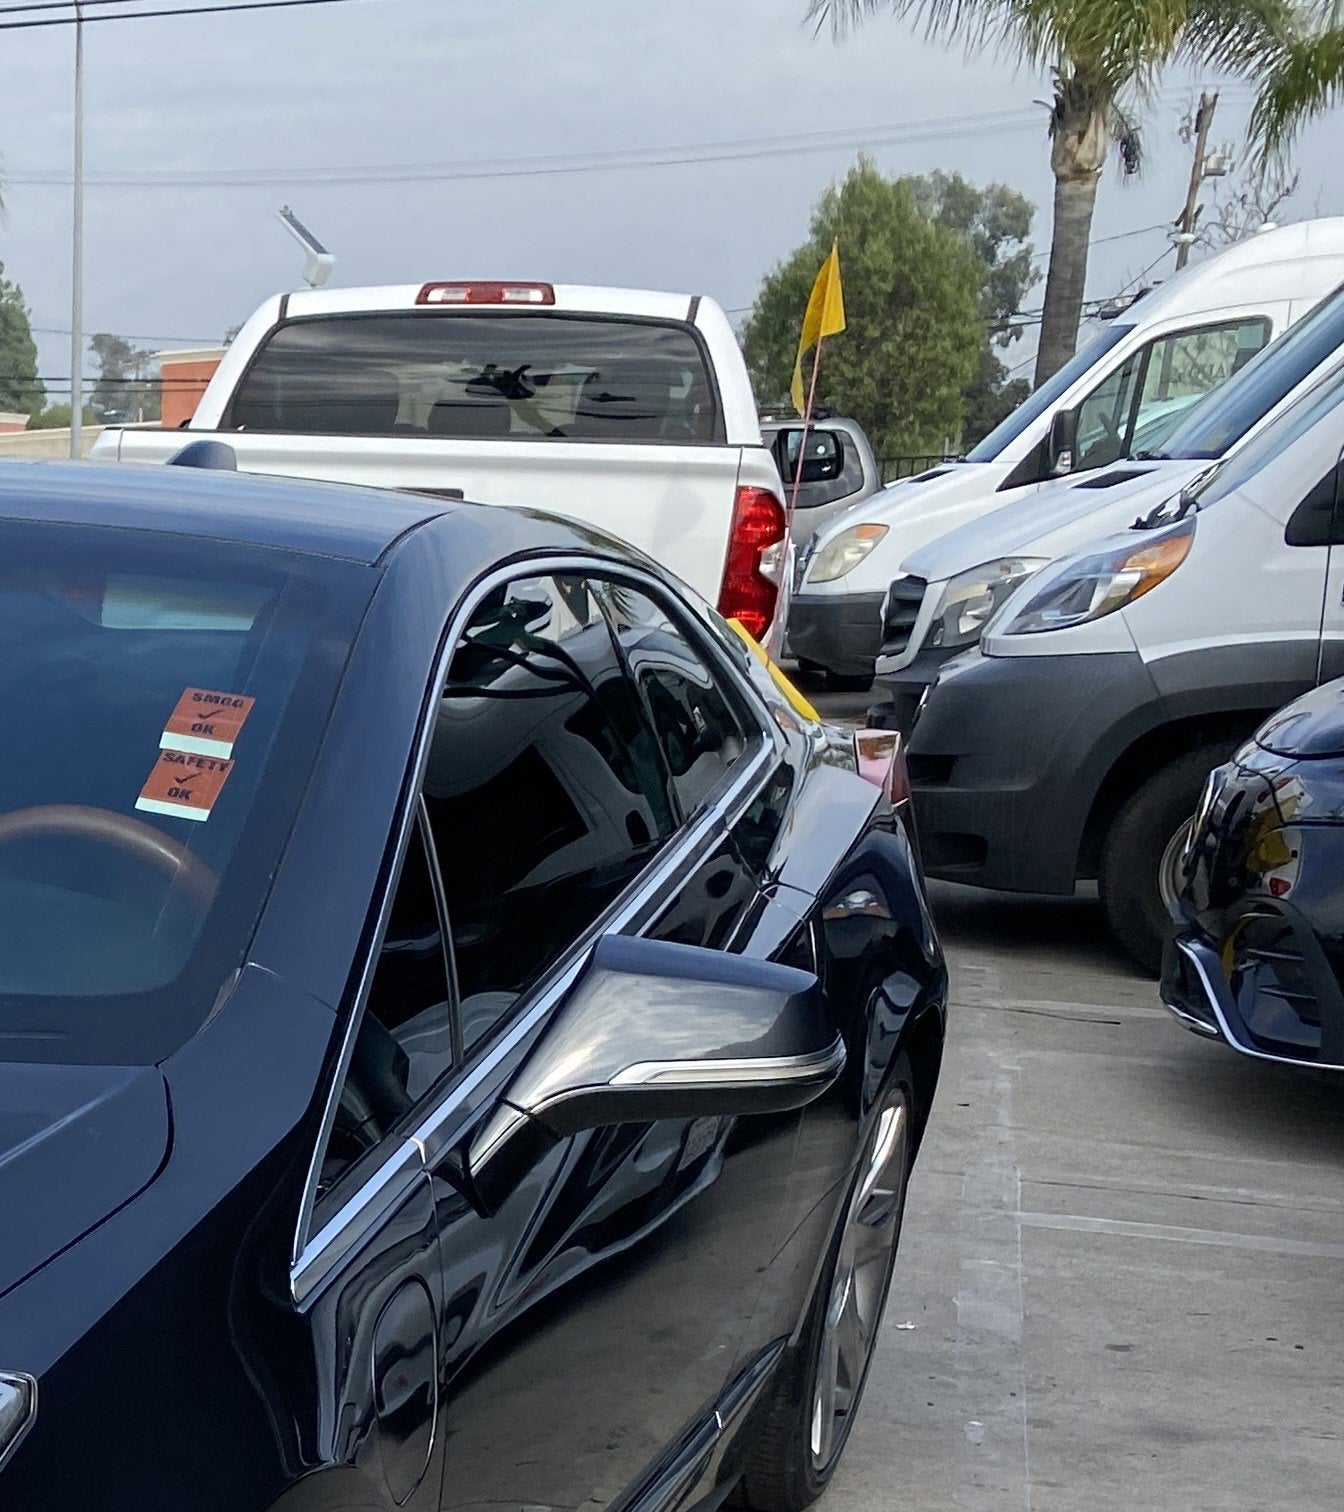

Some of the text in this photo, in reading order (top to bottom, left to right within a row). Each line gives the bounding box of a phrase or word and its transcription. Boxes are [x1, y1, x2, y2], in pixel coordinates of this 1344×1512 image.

[191, 723, 216, 735] OK
[163, 752, 231, 772] SAFETY
[167, 786, 193, 800] OK
